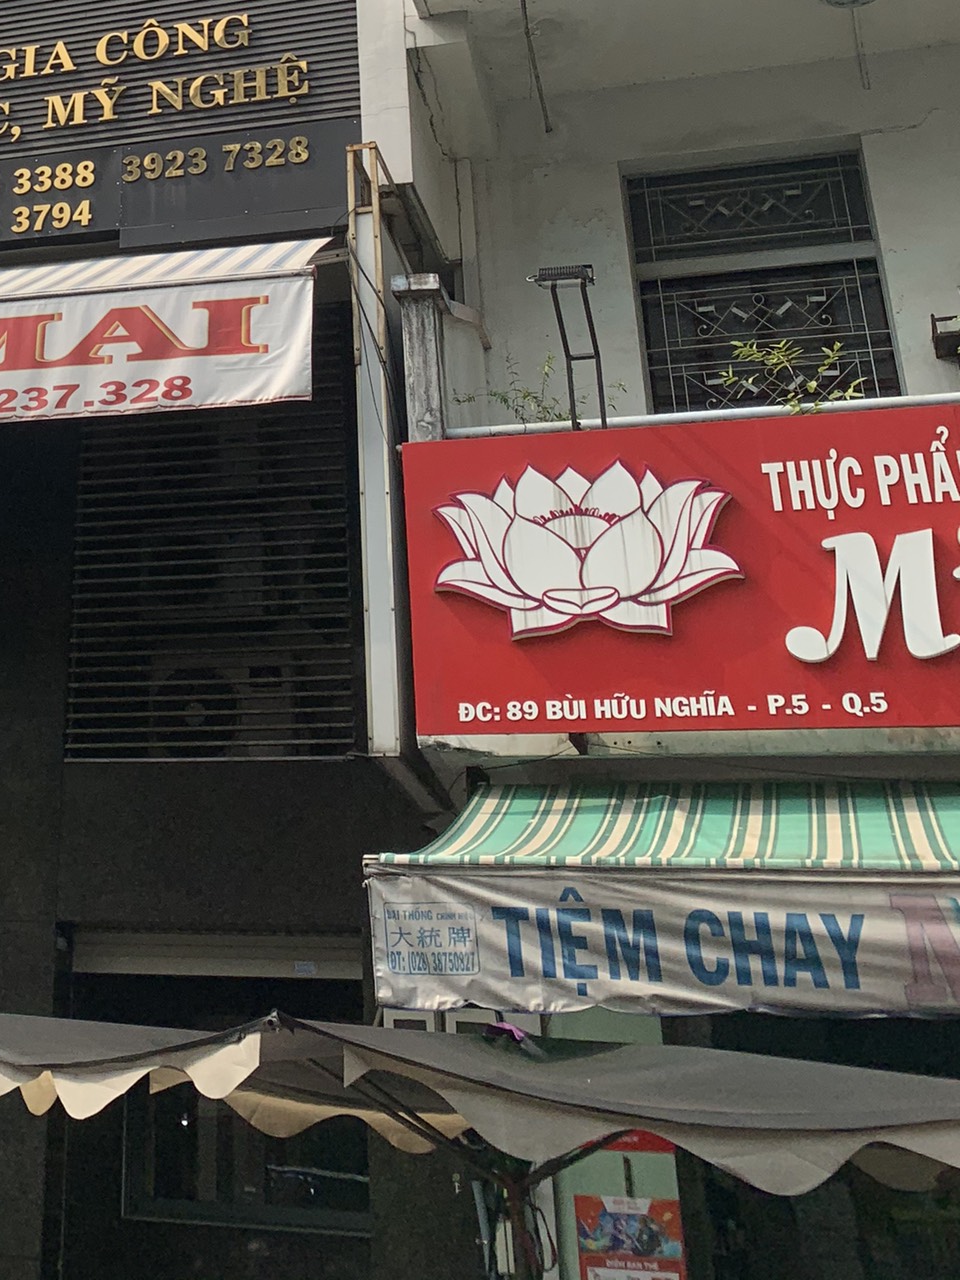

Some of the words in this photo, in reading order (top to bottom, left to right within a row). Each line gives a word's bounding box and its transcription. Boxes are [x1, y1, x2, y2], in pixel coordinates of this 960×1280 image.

[94, 13, 252, 67] CÔNG
[43, 76, 127, 130] MỸ
[147, 53, 311, 116] NGHỆ
[11, 159, 97, 196] 3388
[121, 146, 208, 184] 3923
[221, 135, 311, 173] 7328
[9, 199, 93, 235] 3794
[761, 447, 866, 521] THỰC
[873, 425, 960, 506] PHẨ
[458, 701, 501, 723] ĐC:
[506, 699, 539, 721] 89
[546, 694, 587, 720] BÙI
[594, 692, 647, 720] HỮU
[654, 689, 735, 718] NGHĨA
[767, 694, 810, 716] P.5
[841, 692, 889, 718] Q.5
[491, 886, 662, 997] TIỆM
[684, 908, 865, 990] CHAY
